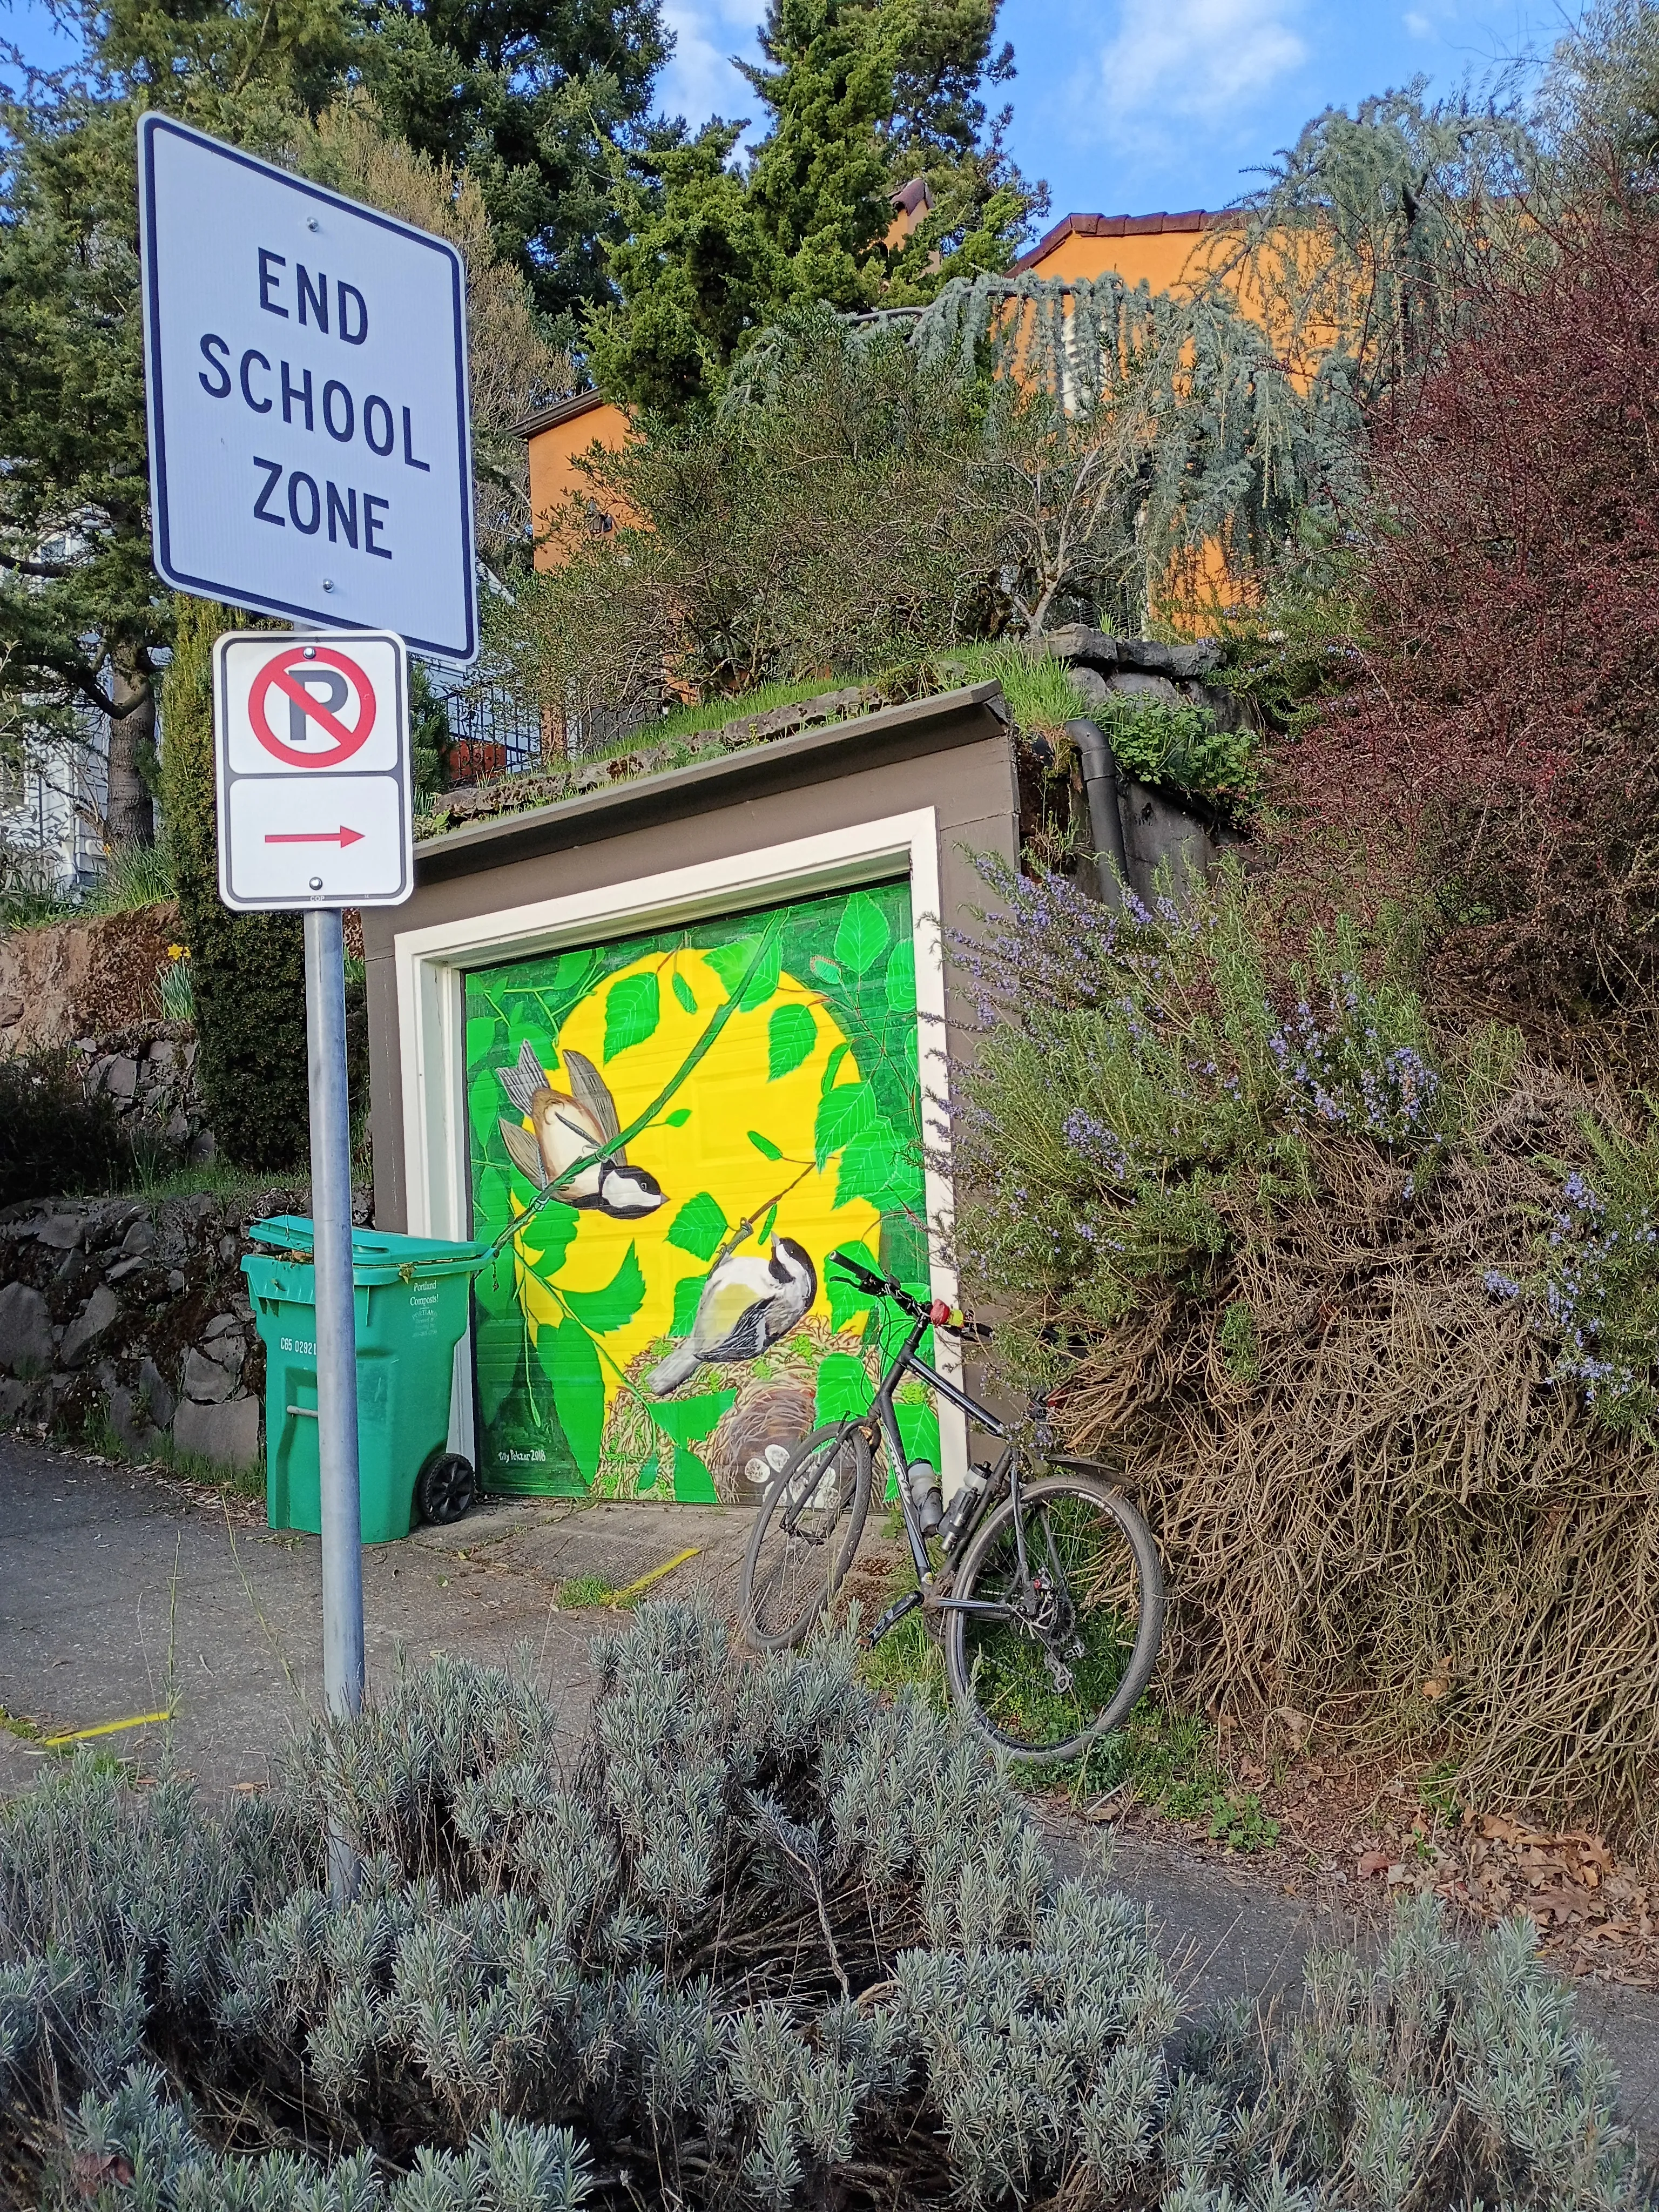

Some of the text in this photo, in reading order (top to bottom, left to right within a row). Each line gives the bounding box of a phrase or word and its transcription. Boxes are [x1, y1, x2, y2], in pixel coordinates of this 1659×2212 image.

[258, 247, 367, 346] END
[198, 333, 430, 473] SCHOOL
[253, 455, 392, 560] ZONE
[414, 1279, 437, 1292] Portland
[410, 1293, 439, 1306] Composts!
[280, 1337, 292, 1351] C65
[530, 1449, 546, 1462] 2018
